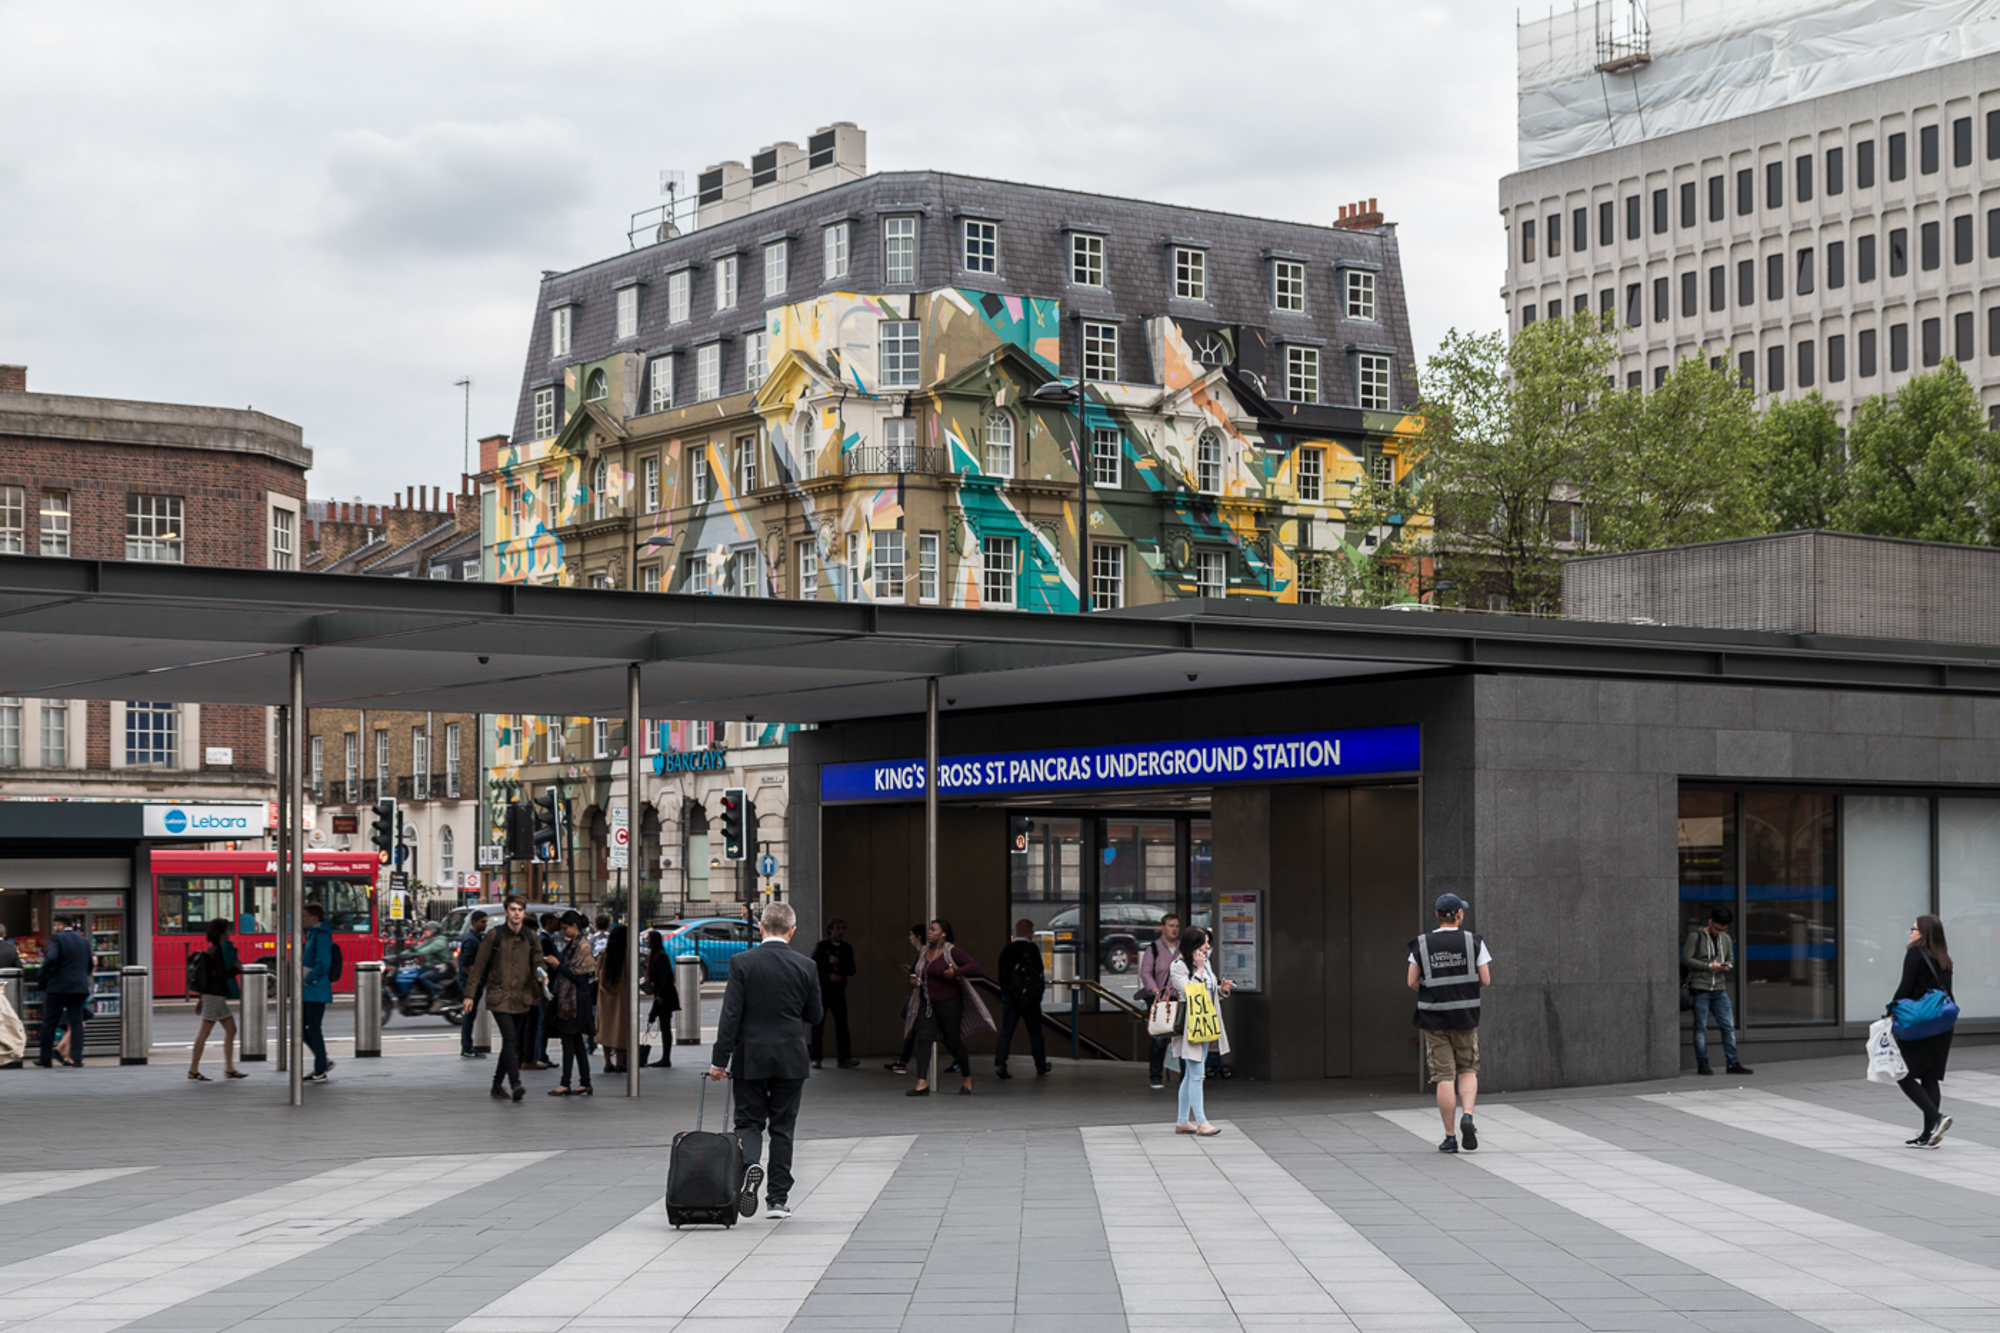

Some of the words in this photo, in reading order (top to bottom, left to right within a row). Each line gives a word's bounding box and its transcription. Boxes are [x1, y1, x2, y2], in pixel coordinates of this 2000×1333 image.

[666, 750, 724, 772] BARCLAYS
[875, 763, 926, 790] KING'S
[937, 762, 982, 786] ROSS
[1096, 747, 1248, 779] UNDERGROUND
[1252, 739, 1340, 770] STATION
[192, 815, 247, 828] Lebara
